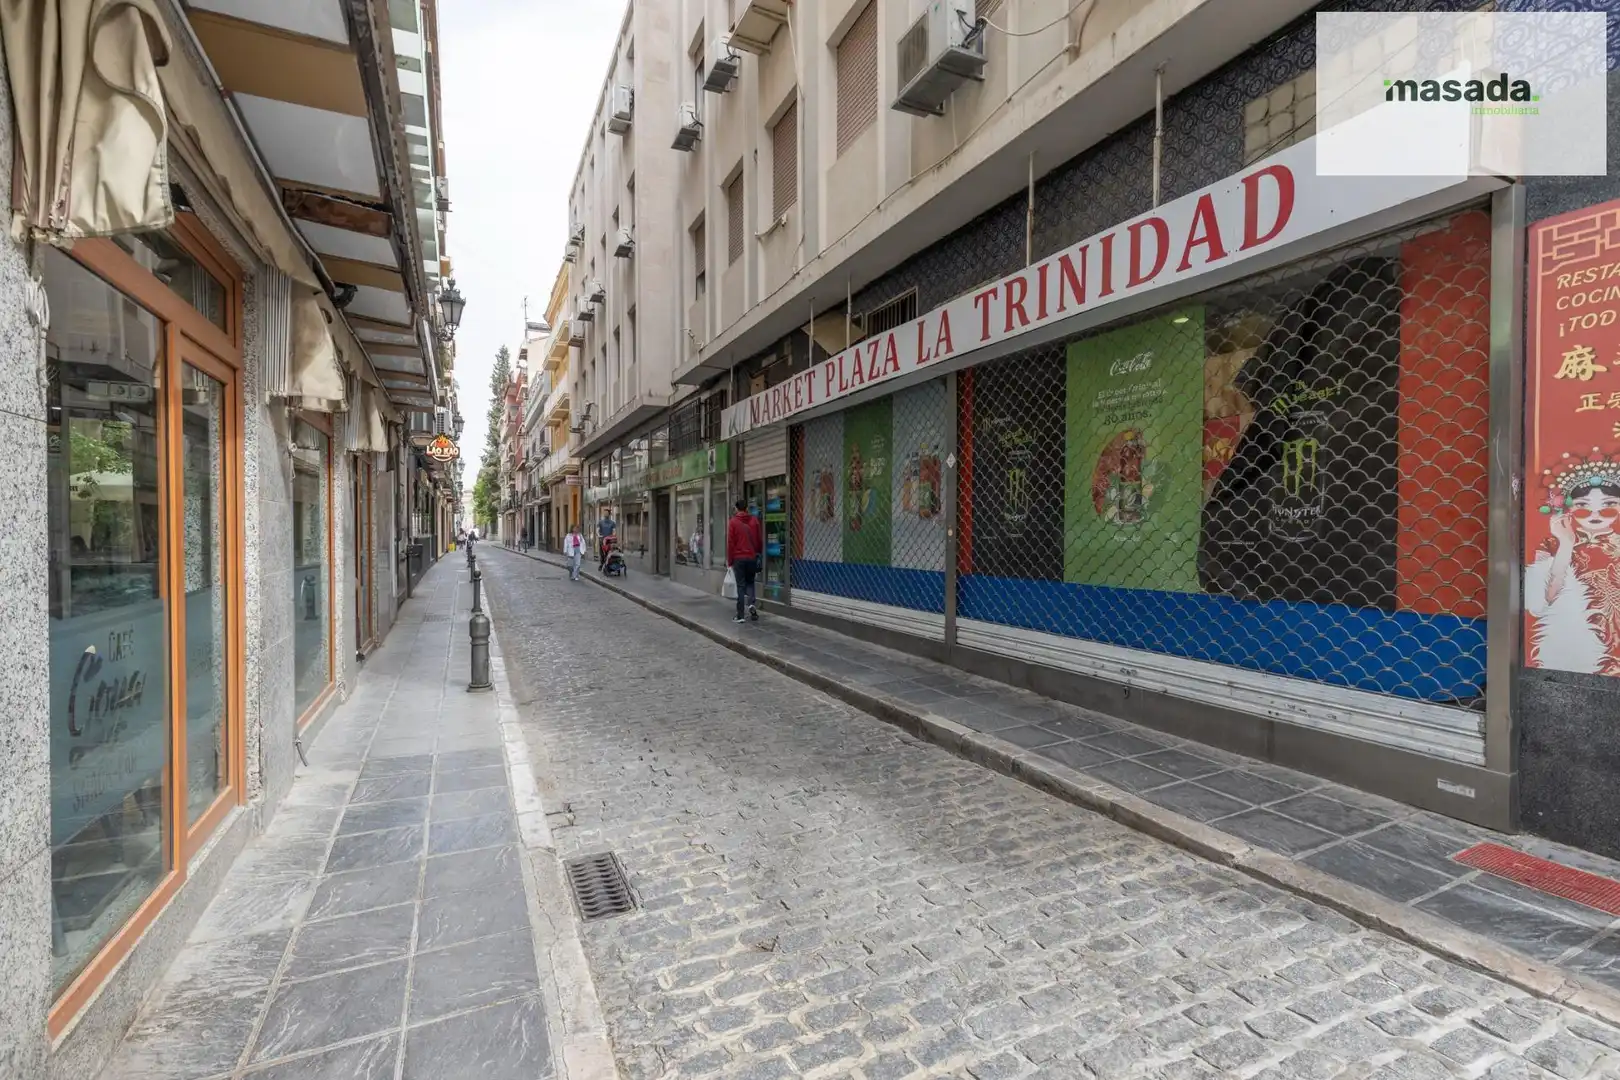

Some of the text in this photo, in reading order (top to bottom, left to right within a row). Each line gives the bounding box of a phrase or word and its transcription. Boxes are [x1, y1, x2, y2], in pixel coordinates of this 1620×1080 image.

[750, 164, 1295, 425] MARKET PLAZA LA TRINIDAD
[1554, 344, 1620, 381] 麻
[426, 445, 442, 455] LAO
